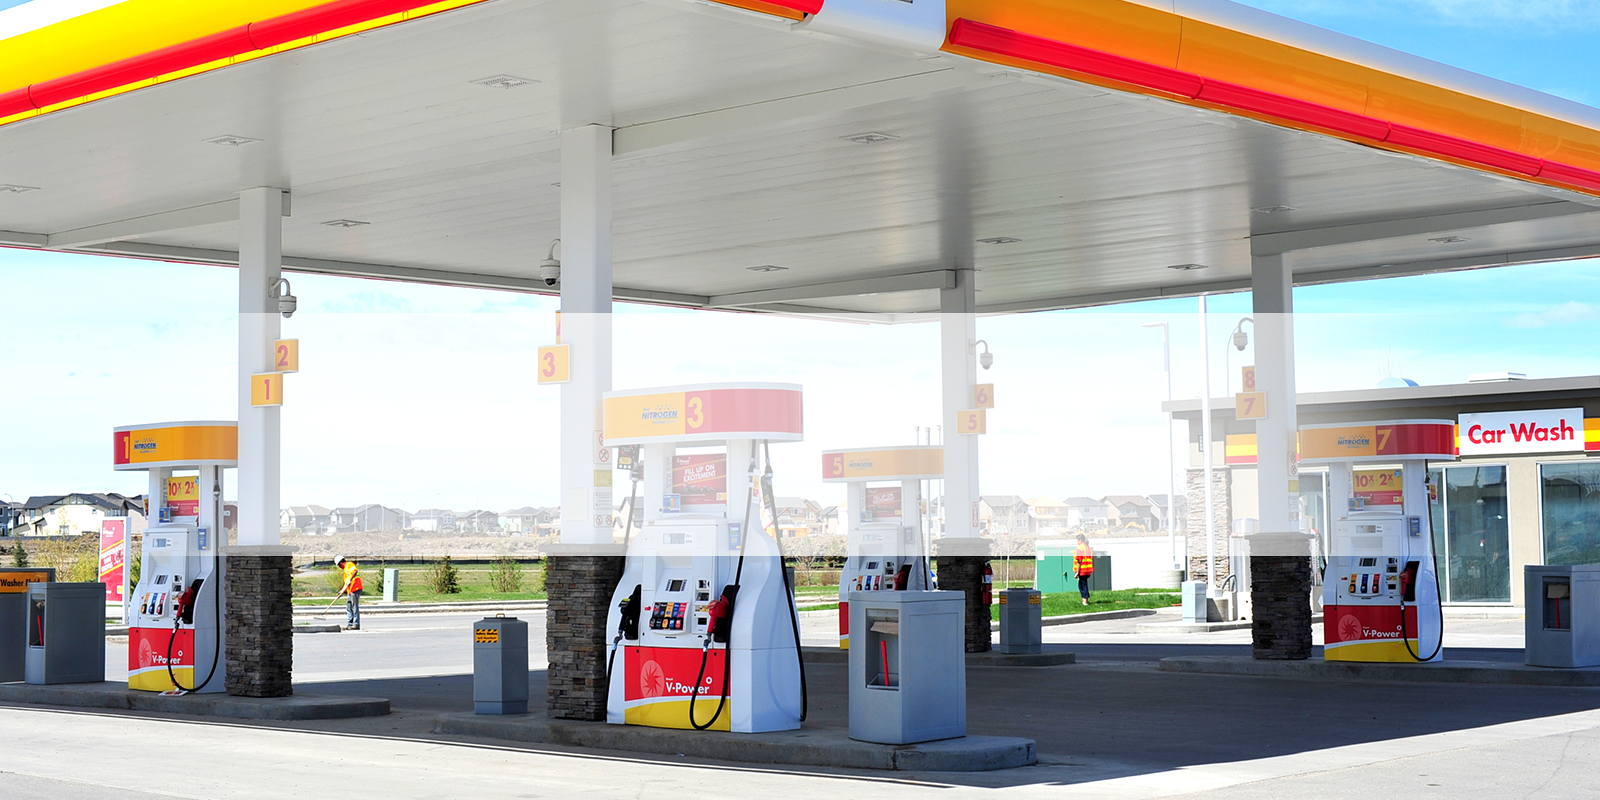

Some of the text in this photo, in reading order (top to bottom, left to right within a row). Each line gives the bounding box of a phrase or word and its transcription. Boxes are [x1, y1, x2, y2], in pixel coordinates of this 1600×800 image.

[277, 344, 289, 367] 2
[542, 351, 556, 378] 3
[1244, 369, 1256, 389] 8
[264, 379, 270, 400] 1
[976, 387, 988, 405] 6
[642, 410, 678, 419] NITROGEN
[687, 396, 704, 429] 3
[1243, 397, 1256, 416] 7
[967, 413, 978, 431] 5
[1467, 418, 1574, 445] Car Wash
[124, 437, 129, 459] 1
[1337, 438, 1370, 446] NITROGEN
[1377, 428, 1393, 451] 7
[684, 468, 695, 476] FILL
[705, 463, 715, 471] ON
[832, 456, 843, 476] 5
[683, 470, 716, 482] EXCITEMENT
[0, 578, 24, 587] Washer
[1362, 629, 1400, 638] V-Power
[666, 682, 709, 694] V-Power
